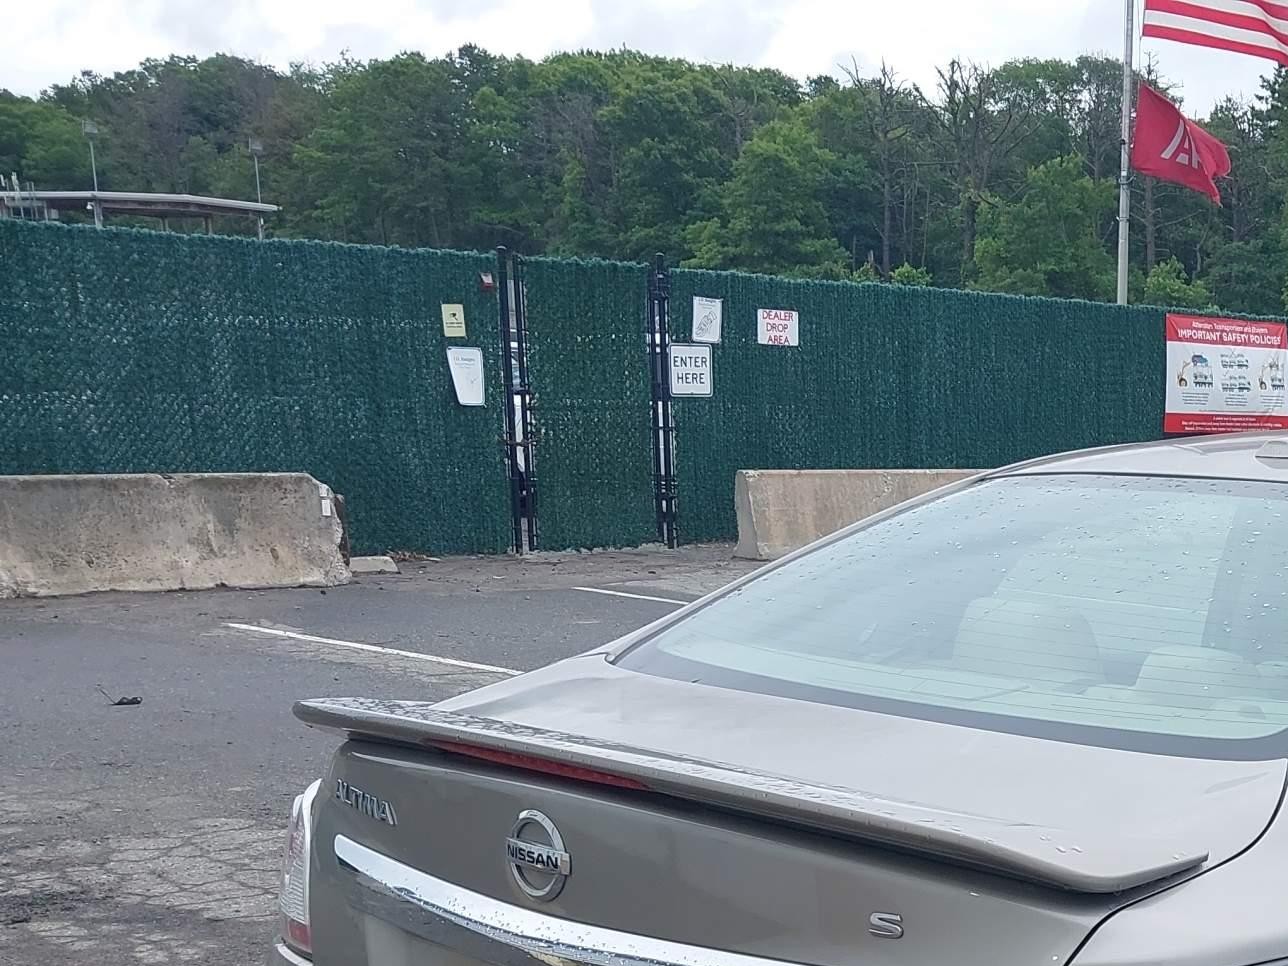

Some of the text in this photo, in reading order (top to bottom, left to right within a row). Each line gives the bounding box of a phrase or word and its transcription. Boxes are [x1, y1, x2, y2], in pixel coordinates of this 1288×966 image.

[762, 311, 793, 322] DEALER
[766, 322, 789, 333] DROP
[767, 335, 791, 346] AREA
[1178, 329, 1282, 346] IMPORTANT SAFETY POLICIES
[673, 356, 707, 369] ENTER
[677, 373, 705, 384] HERE
[336, 778, 397, 825] ALTIMA
[506, 843, 560, 870] NISSAN
[868, 911, 905, 940] S
